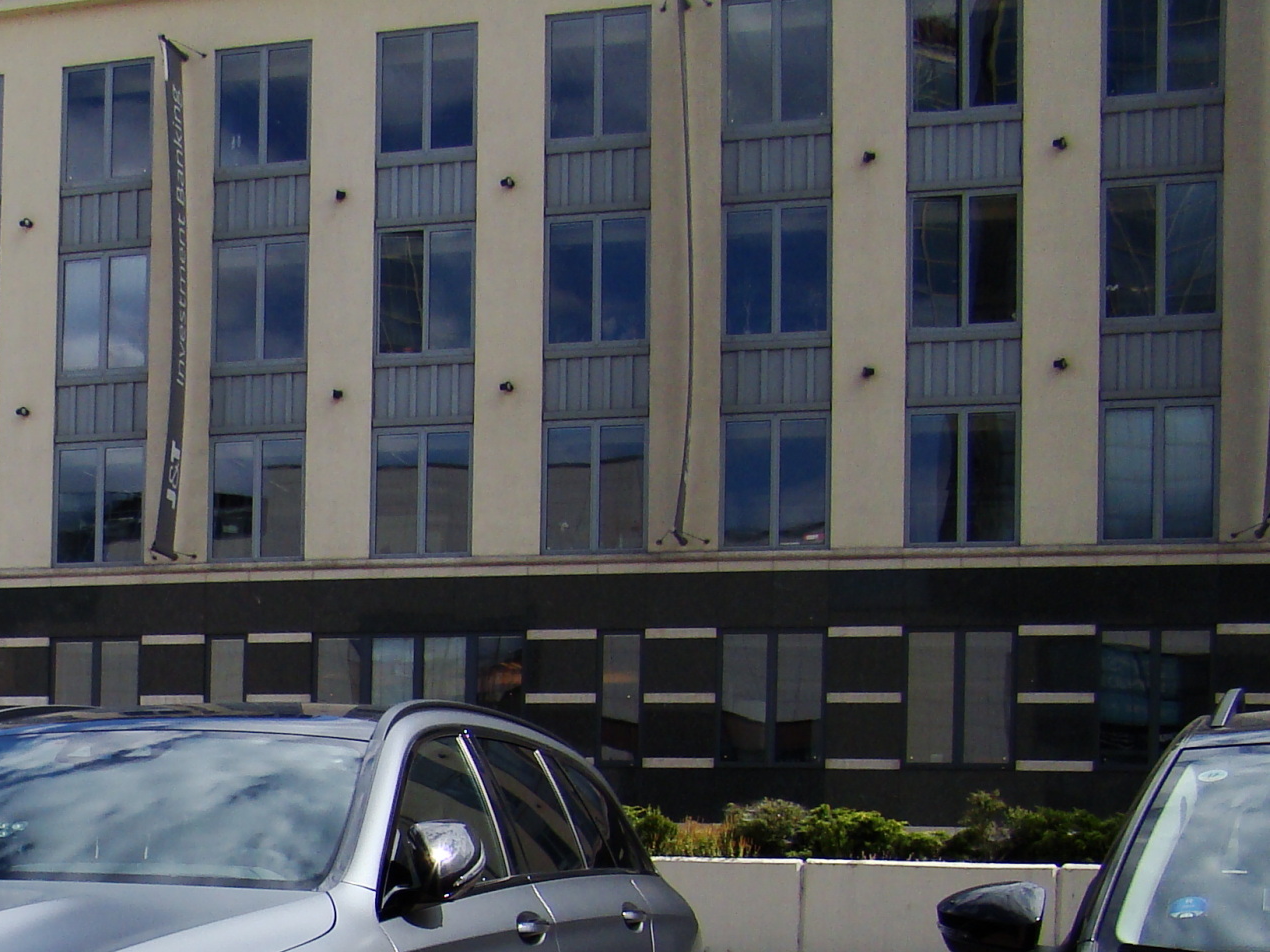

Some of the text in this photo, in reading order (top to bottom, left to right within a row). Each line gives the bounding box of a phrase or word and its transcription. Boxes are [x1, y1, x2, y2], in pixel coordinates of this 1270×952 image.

[166, 84, 187, 510] J&T Investment Banking
